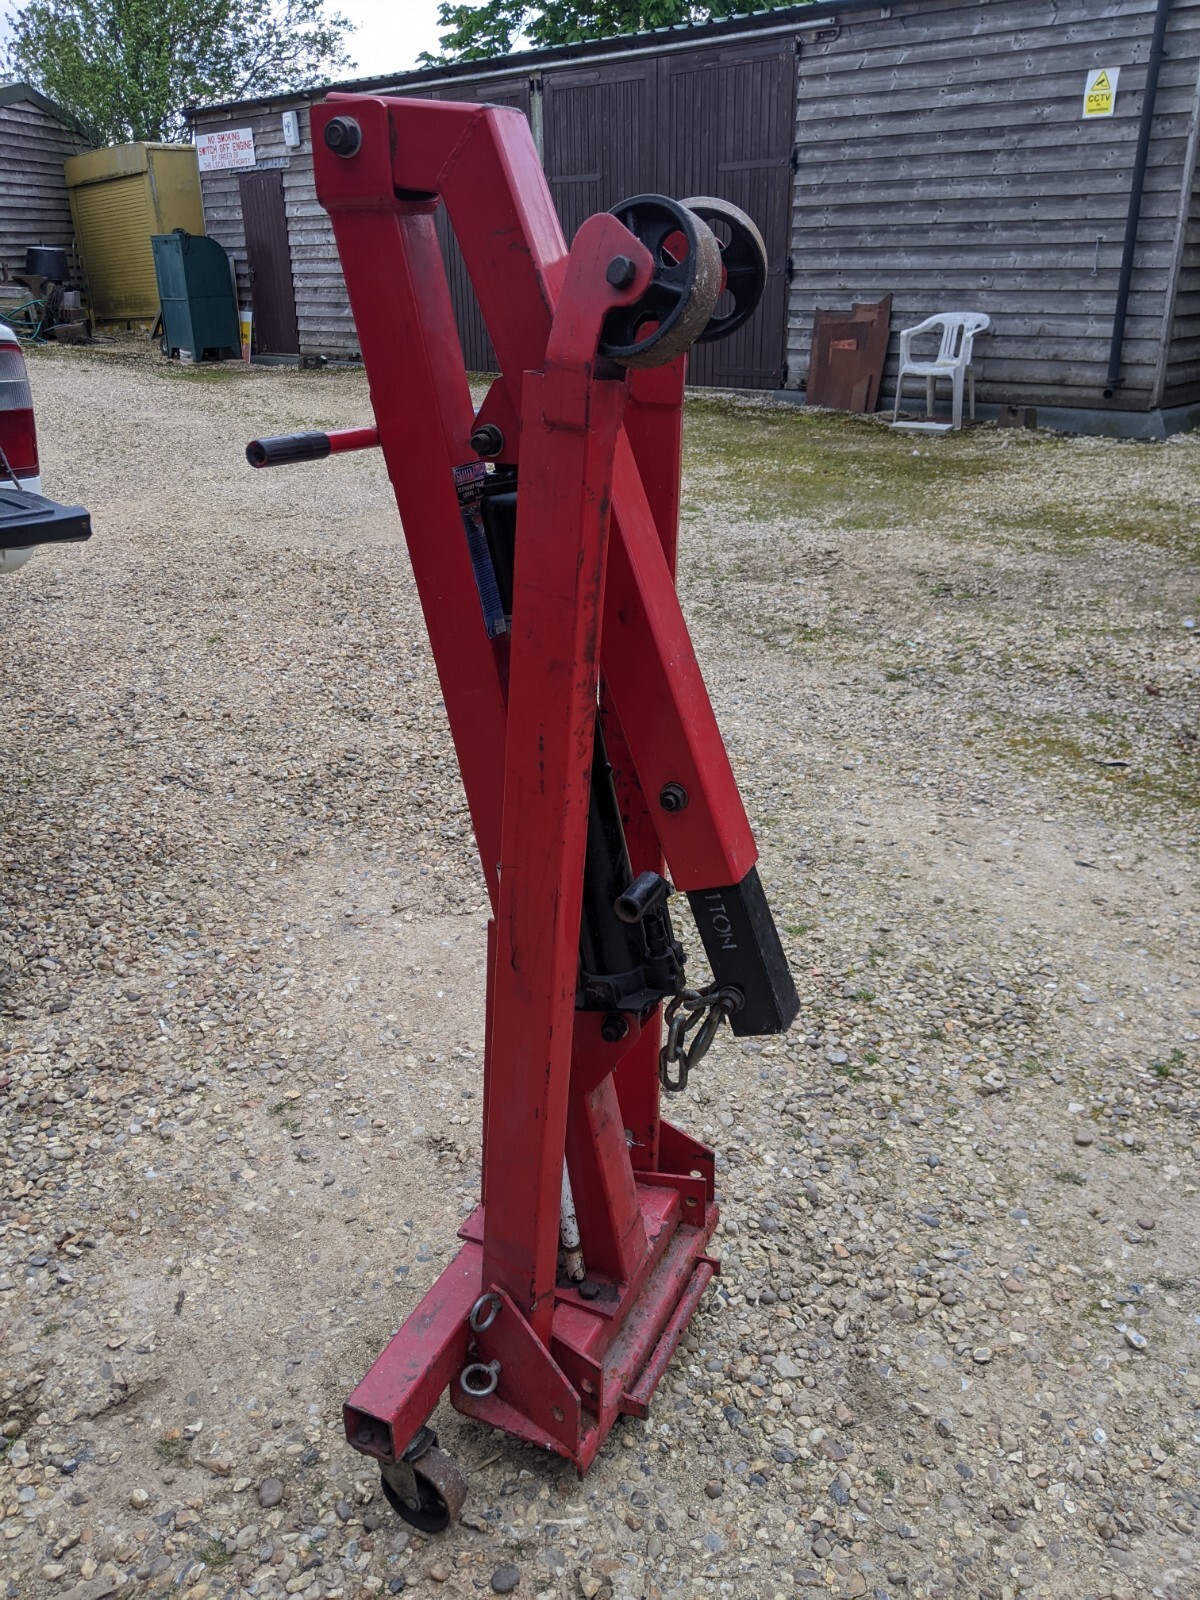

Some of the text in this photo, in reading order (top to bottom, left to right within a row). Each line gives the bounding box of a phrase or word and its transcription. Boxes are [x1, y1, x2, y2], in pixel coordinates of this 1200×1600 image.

[1088, 94, 1110, 102] CCTV
[207, 131, 240, 144] NO SMOKING
[198, 140, 252, 156] SWITCH OFF ENGINE
[709, 904, 737, 949] TON
